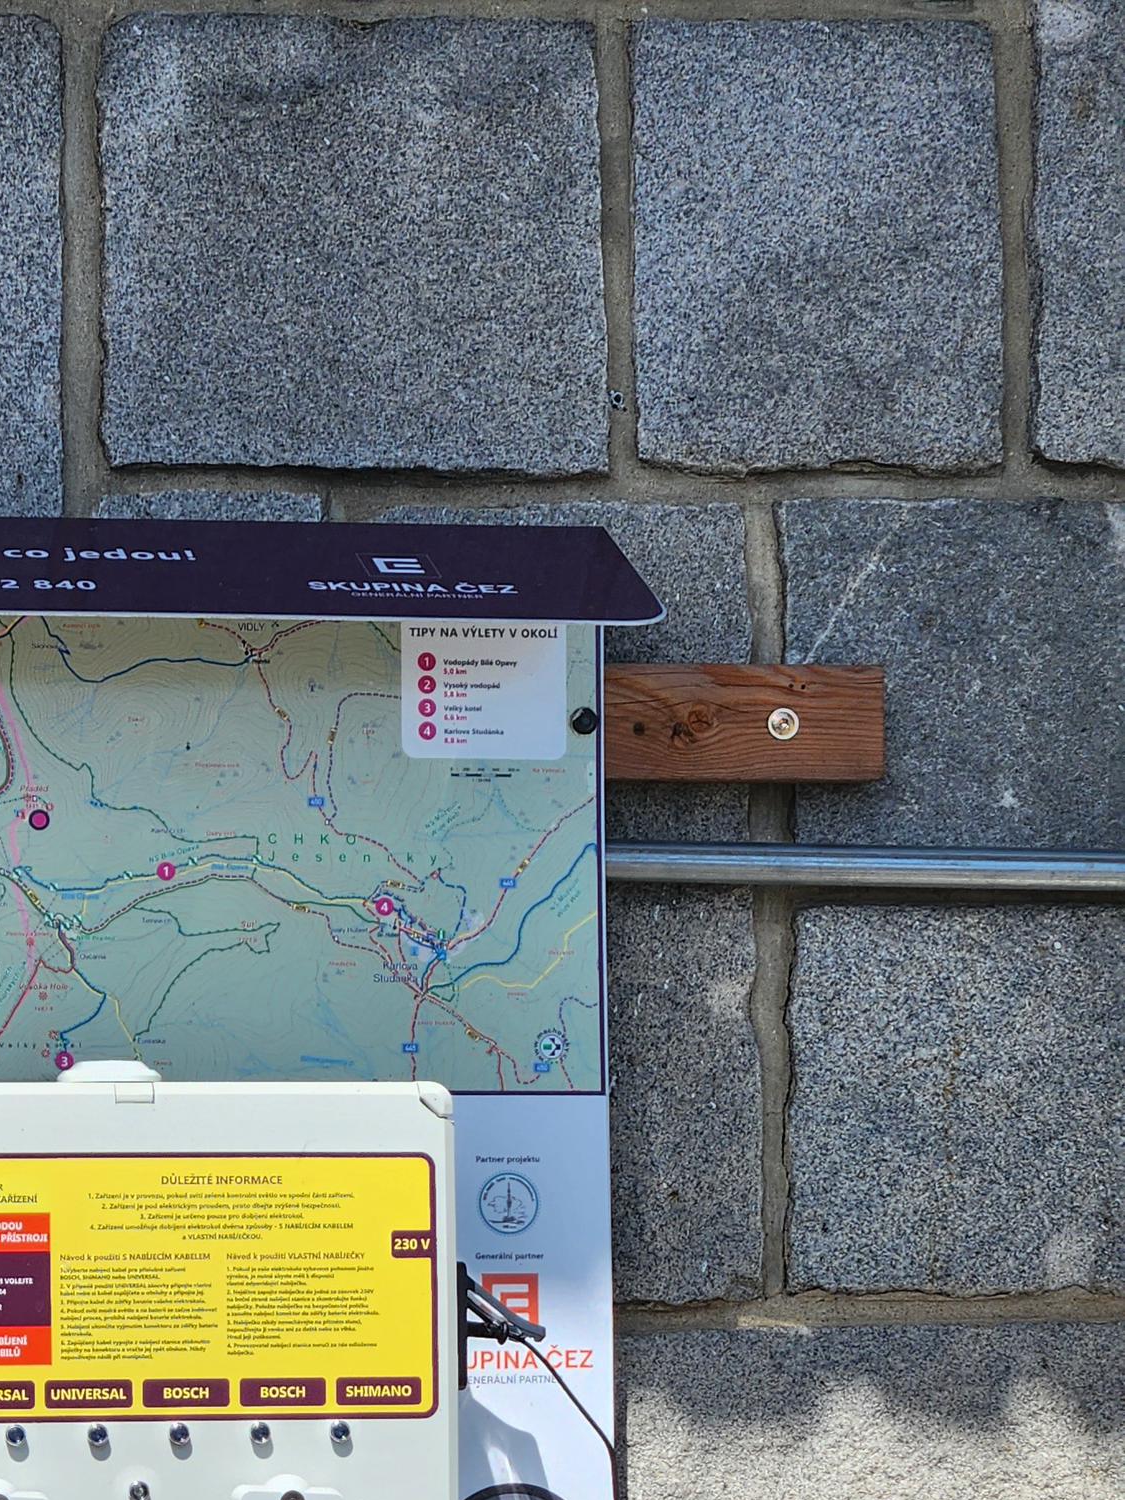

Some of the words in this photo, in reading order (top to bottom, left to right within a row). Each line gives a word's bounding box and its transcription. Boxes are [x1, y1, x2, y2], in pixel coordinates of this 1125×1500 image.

[3, 547, 50, 560] co
[63, 547, 197, 562] jedou!
[32, 579, 98, 591] 840
[307, 581, 449, 593] SKUPINA
[455, 580, 520, 595] ČEZ
[410, 627, 436, 638] TIPY
[440, 628, 458, 638] NA
[462, 625, 506, 639] VÝLETY
[509, 629, 518, 639] V
[521, 626, 559, 640] OKOLÍ
[475, 1154, 506, 1164] Partner
[506, 1154, 541, 1165] projektu
[161, 1173, 213, 1185] DŮLEŽITÉ
[215, 1174, 283, 1185] INFORMACE
[0, 1232, 49, 1244] PŘÍSTROJI
[394, 1238, 418, 1250] 230
[419, 1238, 431, 1250] V
[475, 1251, 513, 1260] Generální
[514, 1252, 545, 1262] partner
[4, 1278, 34, 1286] VOLEJTE
[468, 1350, 539, 1370] UPINA
[546, 1345, 594, 1369] ČEZ
[468, 1373, 517, 1385] ENERÁLNÍ
[519, 1374, 559, 1385] PARTNE
[50, 1388, 127, 1401] UNIVERSAL
[163, 1386, 210, 1400] BOSCH
[259, 1386, 306, 1399] BOSCH
[345, 1384, 413, 1398] SHIMANO
